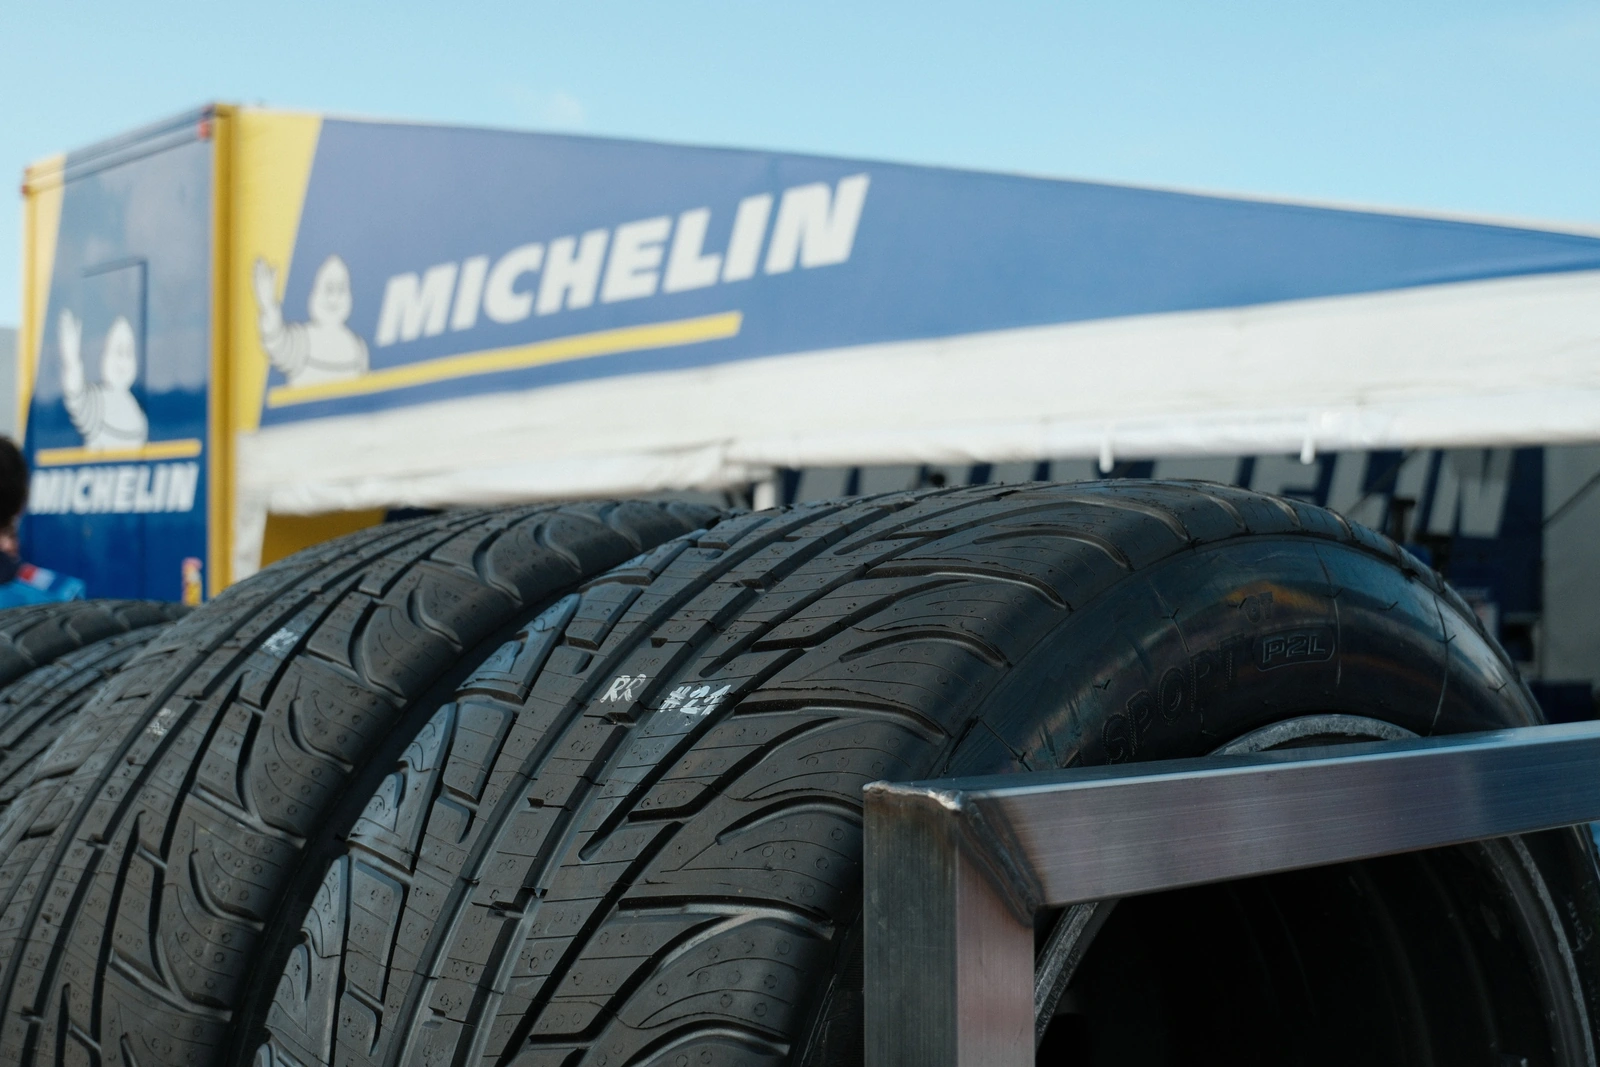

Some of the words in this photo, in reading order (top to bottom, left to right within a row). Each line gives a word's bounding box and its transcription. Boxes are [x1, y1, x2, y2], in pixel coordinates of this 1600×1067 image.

[374, 173, 870, 347] MICHELIN
[28, 461, 199, 515] MICHELIN
[1262, 633, 1327, 664] P2L
[599, 673, 647, 703] RR
